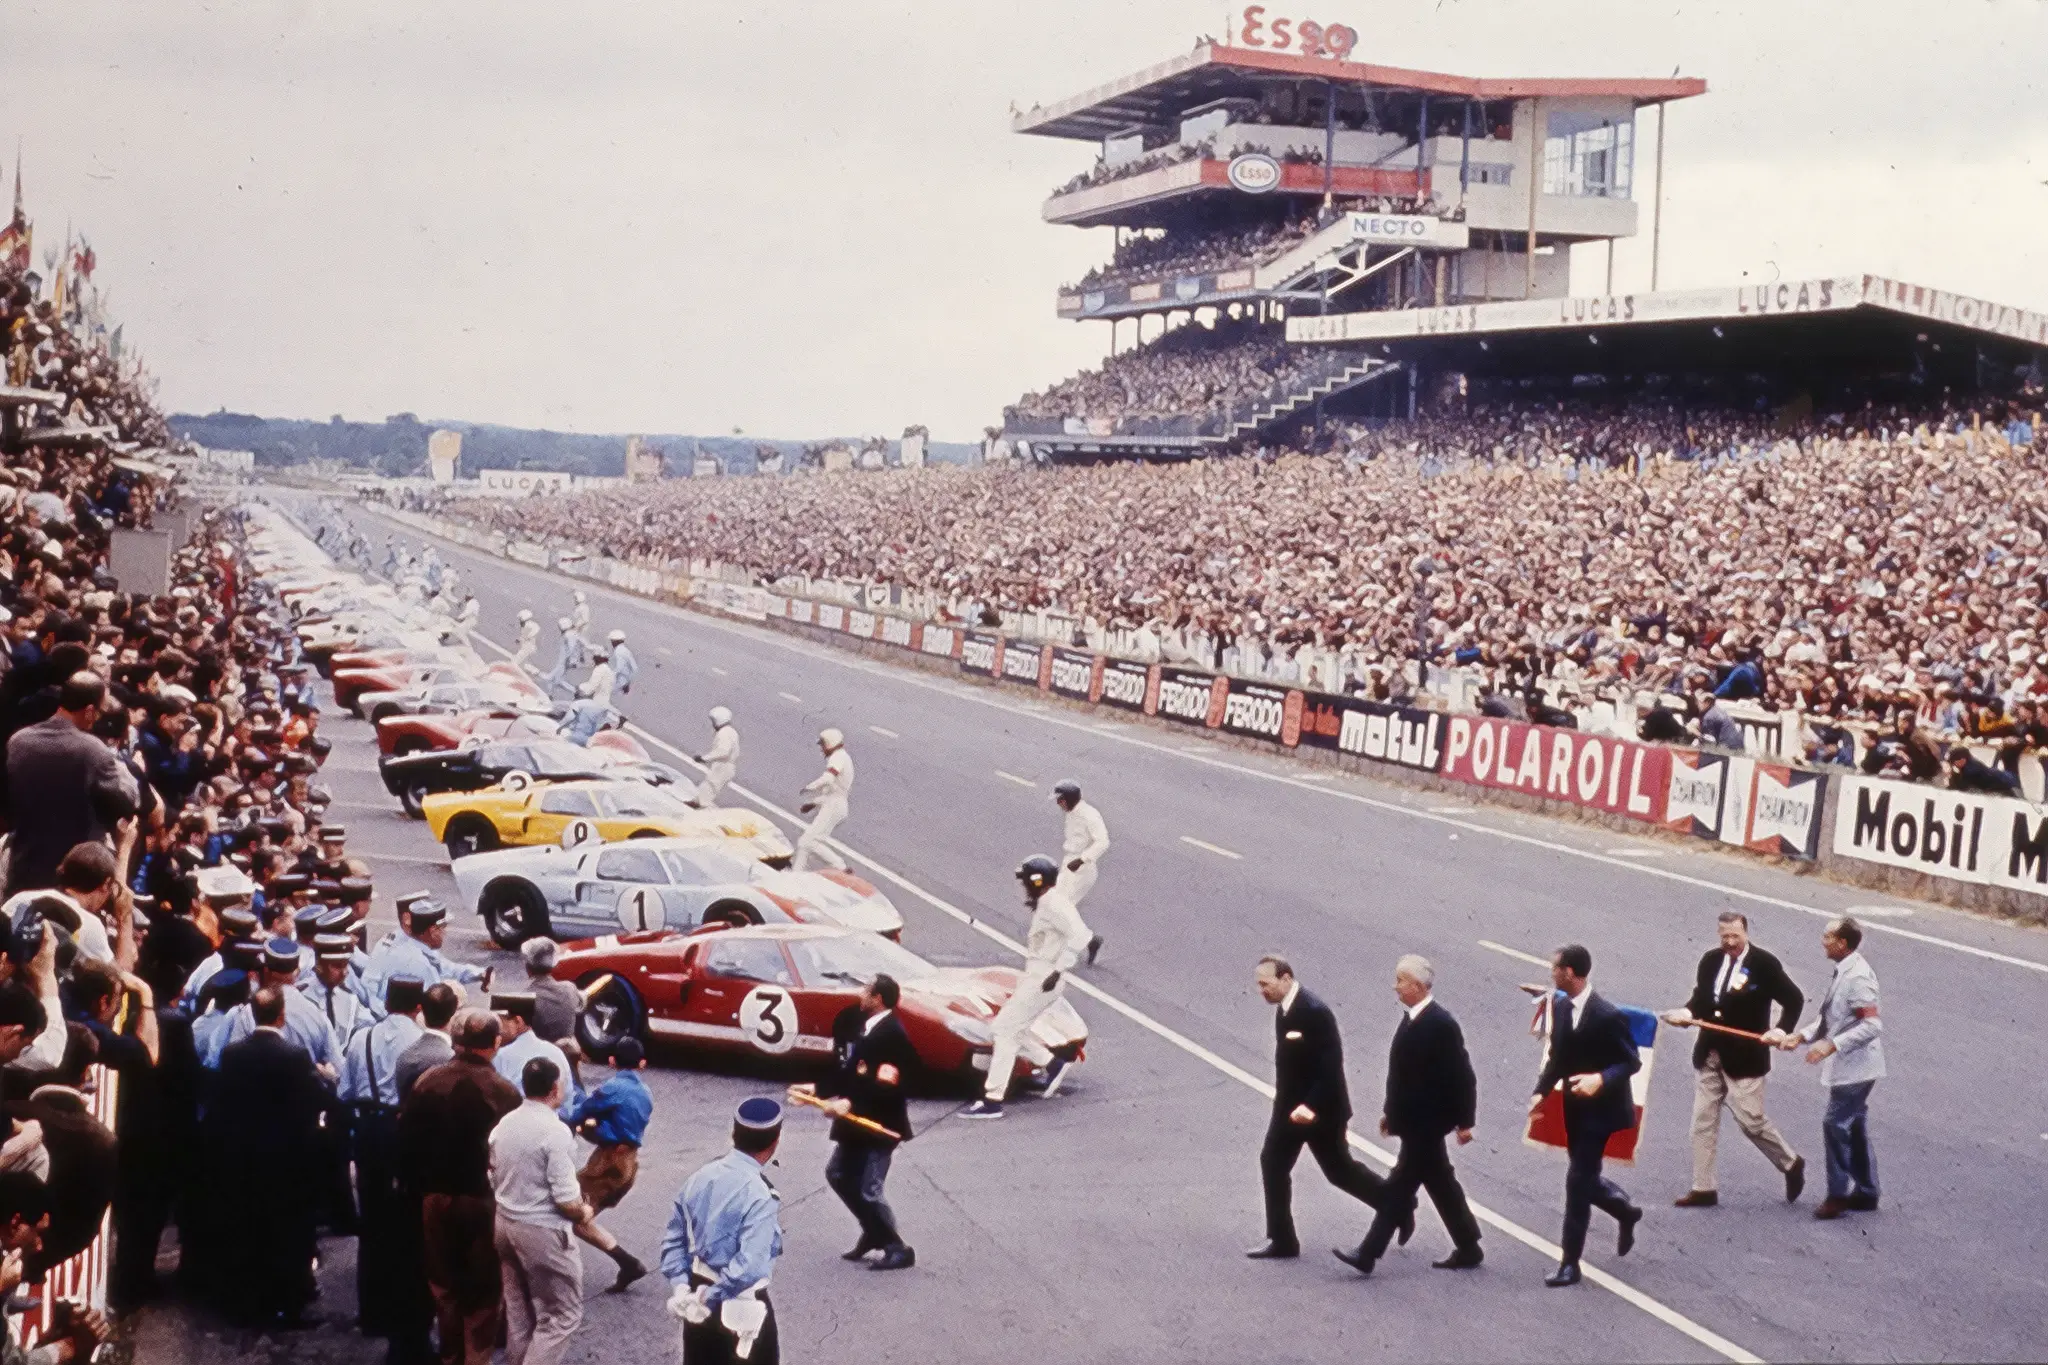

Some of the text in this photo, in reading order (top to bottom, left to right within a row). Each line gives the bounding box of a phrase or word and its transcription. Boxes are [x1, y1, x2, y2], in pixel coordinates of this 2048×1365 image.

[1353, 217, 1426, 236] NECTO
[1561, 295, 1634, 323] LUCAS
[1738, 279, 1834, 314] LUCAS
[1416, 305, 1476, 335] LUCAS
[1158, 680, 1210, 720] FERODO
[1223, 692, 1283, 736] FERODO
[1339, 708, 1440, 769] motul
[1445, 717, 1651, 815] POLAROIL
[1853, 786, 1984, 873] Mobil
[2008, 811, 2048, 884] M
[632, 889, 648, 932] 1
[755, 991, 785, 1044] 3
